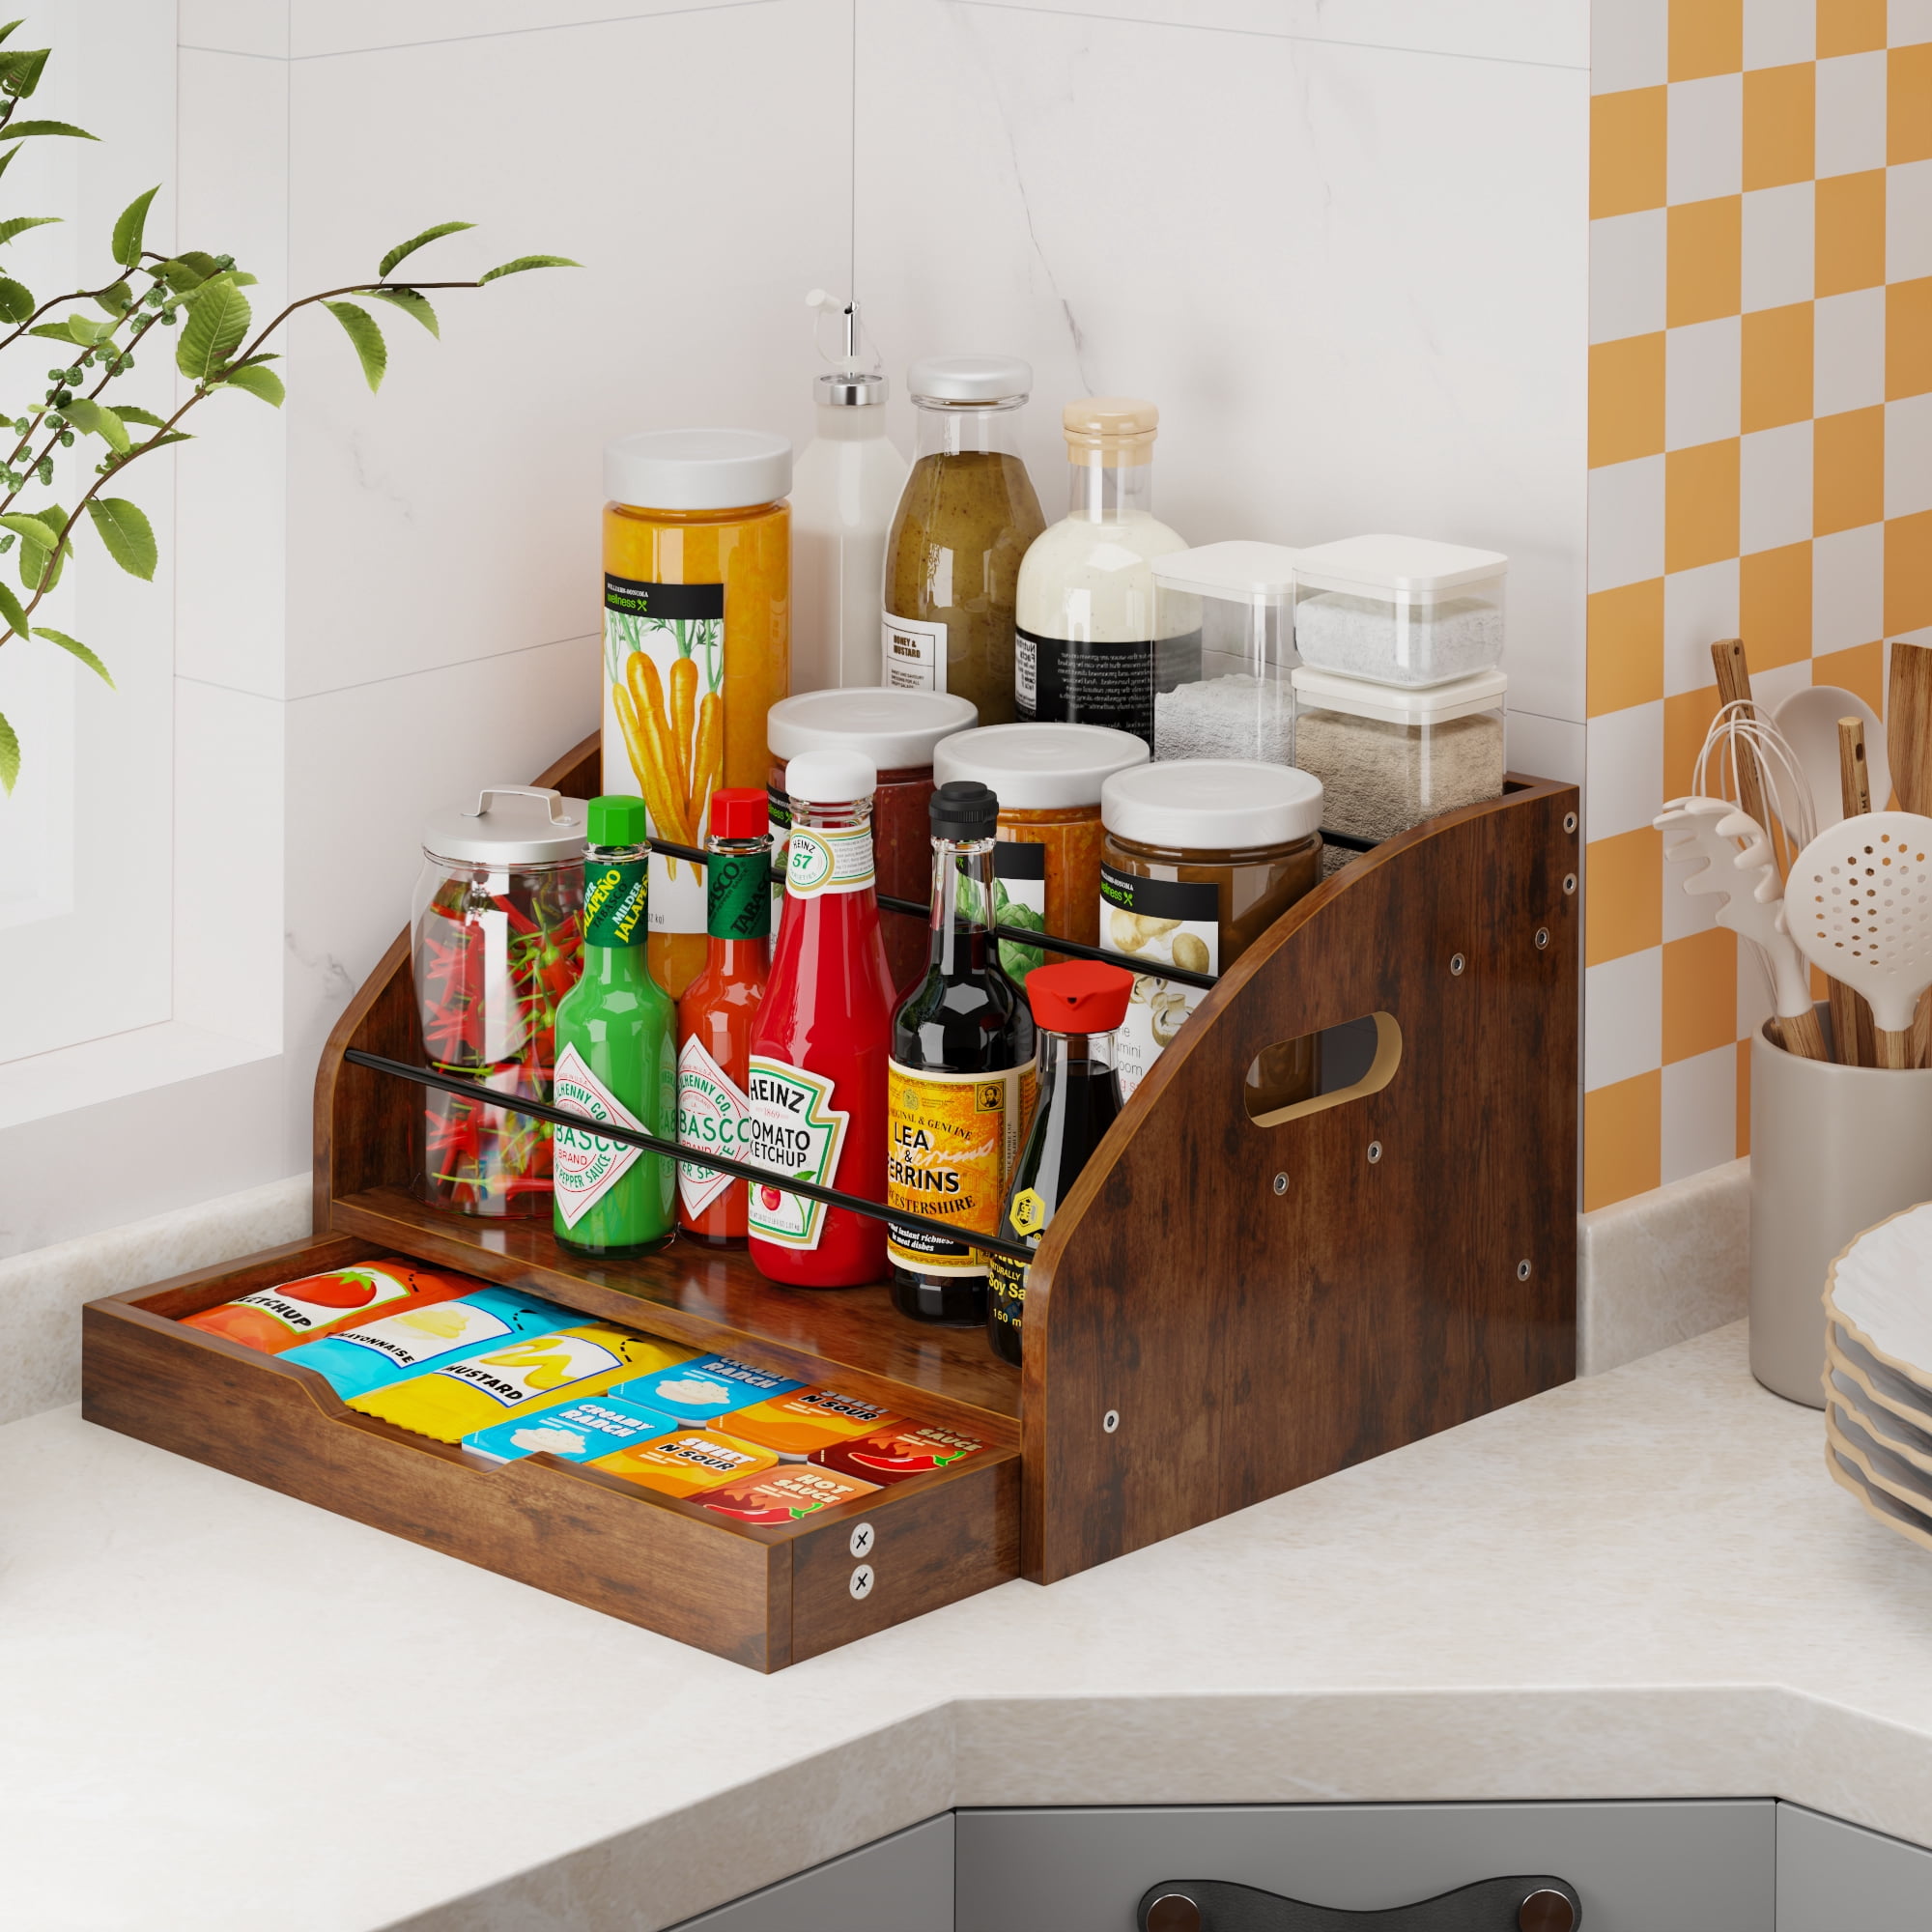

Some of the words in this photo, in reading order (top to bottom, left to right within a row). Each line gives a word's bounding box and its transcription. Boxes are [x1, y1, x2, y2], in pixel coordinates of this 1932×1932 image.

[893, 644, 921, 659] MUSTARD
[894, 634, 911, 647] HONEY
[911, 639, 917, 648] &
[793, 838, 816, 854] HEINZ
[792, 853, 813, 870] 57
[584, 869, 621, 939] ALAPEÑO
[593, 883, 627, 928] TABASCO
[611, 882, 642, 925] MILDER
[715, 1094, 731, 1117] CO.
[750, 1078, 806, 1114] HEINZ
[750, 1116, 810, 1151] OMATO
[895, 1122, 929, 1151] LEA
[918, 1116, 924, 1125] &
[927, 1119, 973, 1141] GENUINE
[557, 1149, 588, 1166] BRAND
[904, 1150, 913, 1163] &
[559, 1169, 585, 1189] PEPPER
[584, 1153, 611, 1183] SAUCE
[889, 1156, 959, 1193] ERRINS
[898, 1227, 921, 1240] instant
[911, 1240, 935, 1252] dishes
[988, 1271, 1007, 1296] Soy
[234, 1296, 312, 1326] KETCHUP
[337, 1332, 415, 1364] MAYONNAISE
[442, 1365, 524, 1401] MUSTARD
[798, 1394, 826, 1405] N
[818, 1401, 879, 1422] SOUR
[676, 1437, 757, 1464] SWEET
[914, 1428, 983, 1452] SAUCE
[655, 1442, 681, 1453] N
[678, 1448, 737, 1472] SOUR
[773, 1478, 841, 1504] SAUCE
[794, 1473, 856, 1494] HOT
